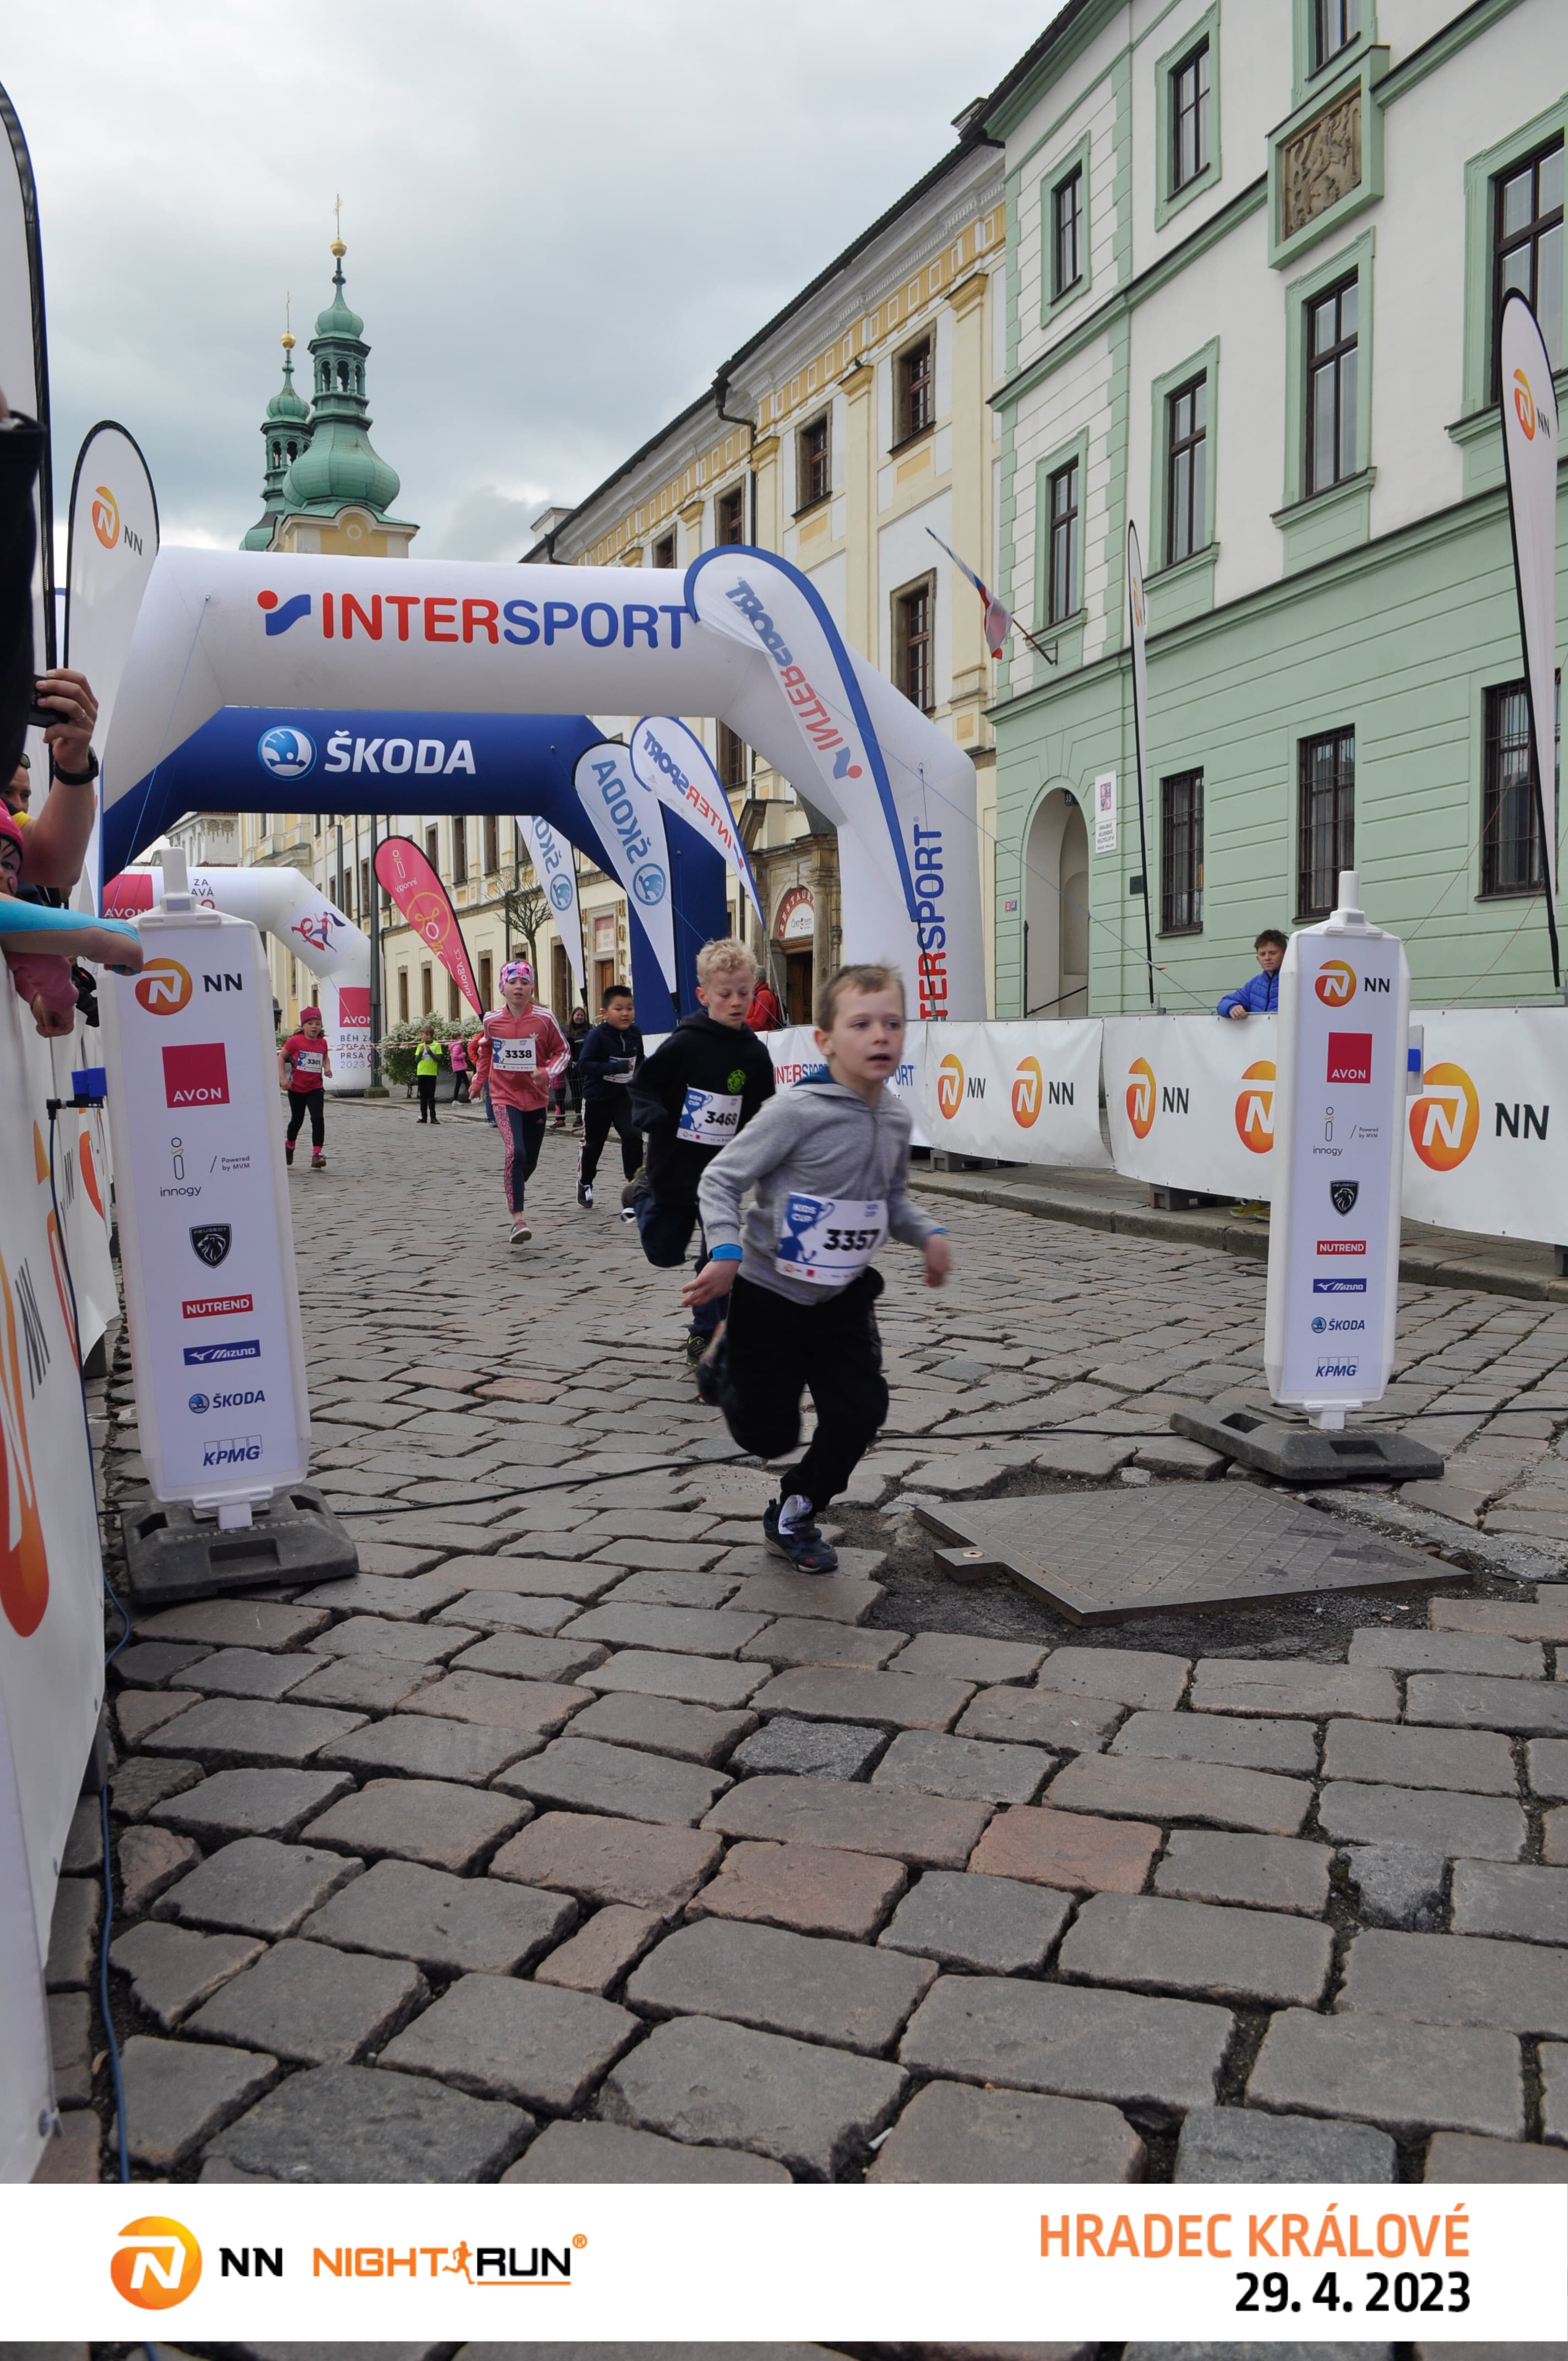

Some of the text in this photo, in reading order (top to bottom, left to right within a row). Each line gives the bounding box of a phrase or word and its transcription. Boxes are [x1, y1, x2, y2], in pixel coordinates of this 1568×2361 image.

[1537, 407, 1551, 439] NN
[124, 526, 143, 556] NN
[322, 592, 688, 649] INTERSPORT
[324, 730, 476, 775] ŠKODA
[914, 824, 949, 1020] TERSPORT
[203, 973, 243, 993] NN
[1364, 977, 1390, 993] NN
[340, 1033, 358, 1042] BĚH
[505, 1050, 532, 1058] 3338
[1331, 1069, 1366, 1079] AVON
[173, 1087, 221, 1102] AVON
[967, 1077, 986, 1099] NN
[1048, 1080, 1074, 1106] NN
[1162, 1086, 1189, 1114] NN
[1495, 1102, 1550, 1141] NN
[221, 1155, 250, 1163] Powered
[1313, 1146, 1343, 1156] innogy
[160, 1184, 202, 1197] innogy
[823, 1228, 880, 1251] 3357
[1320, 1243, 1364, 1252] NUTREND
[186, 1298, 250, 1315] NUTREND
[1328, 1318, 1365, 1331] ŠKODA
[1315, 1364, 1357, 1377] KPMG
[213, 1390, 265, 1408] ŠKODA
[203, 1445, 261, 1466] KPMG
